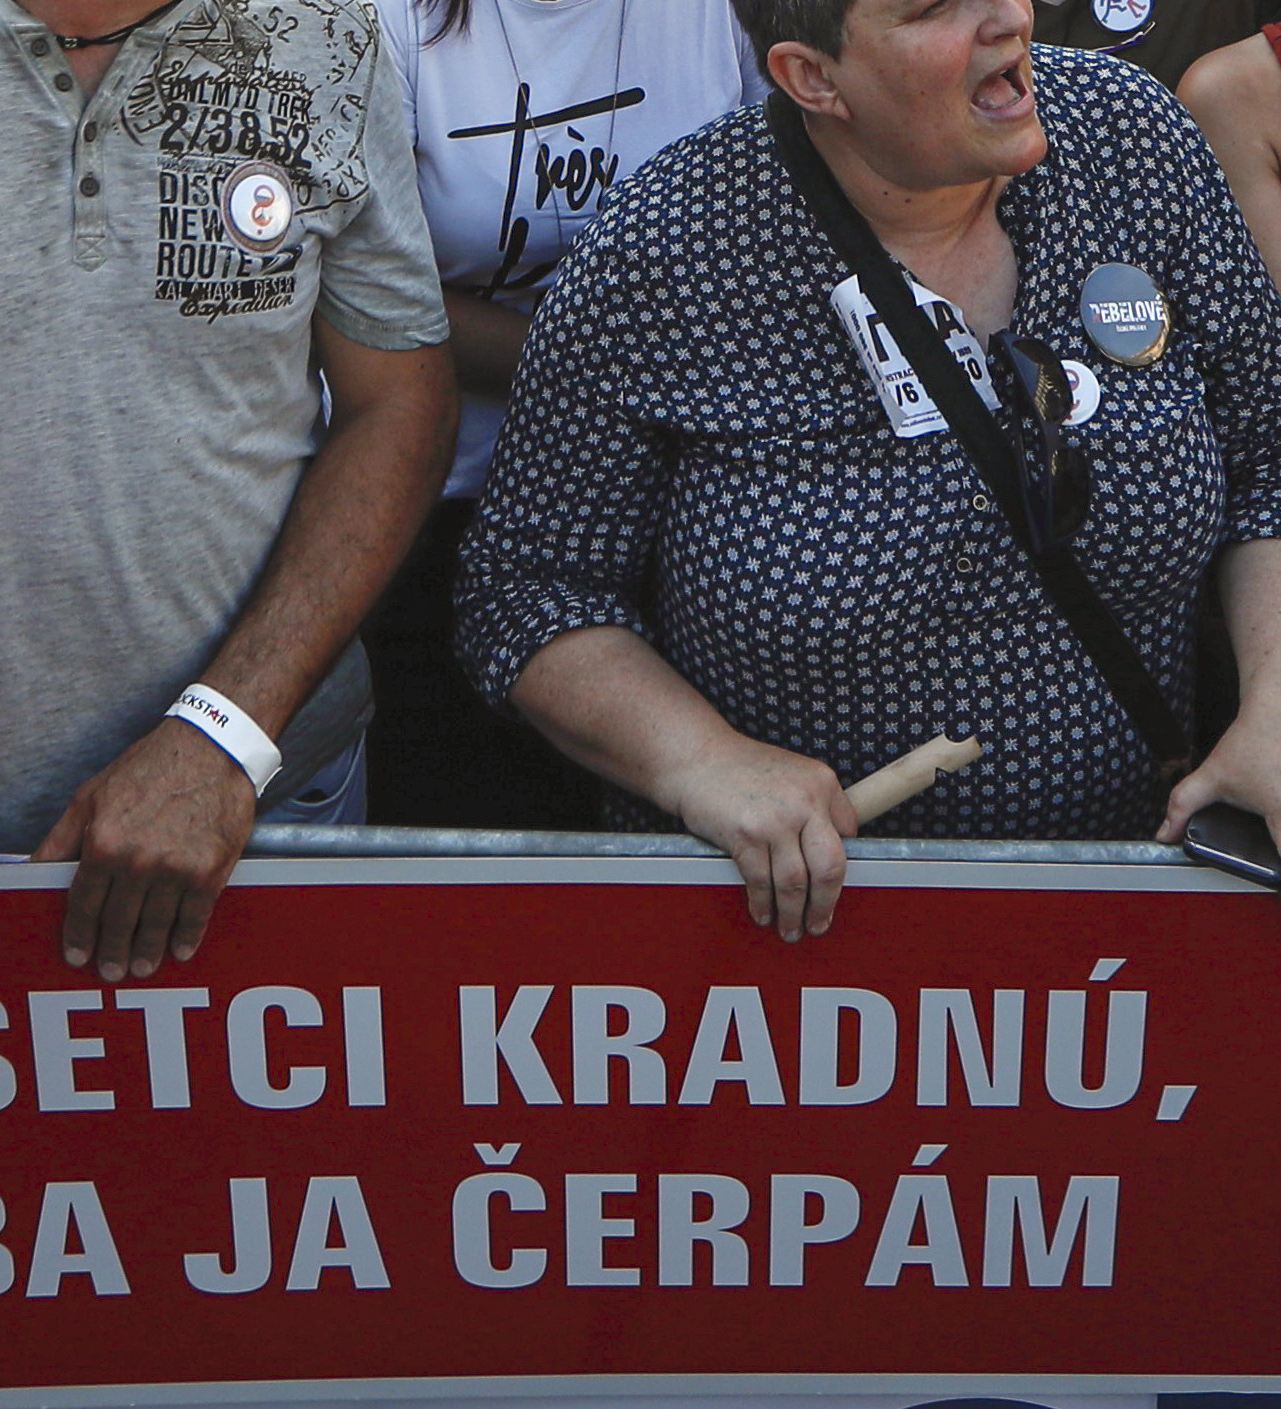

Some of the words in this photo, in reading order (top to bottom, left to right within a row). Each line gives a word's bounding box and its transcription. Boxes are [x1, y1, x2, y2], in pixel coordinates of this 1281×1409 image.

[156, 242, 253, 280] ROUTE
[457, 956, 1200, 1123] KRADNÚ,
[183, 1174, 393, 1294] JA
[449, 1140, 1124, 1293] ČERPÁM
